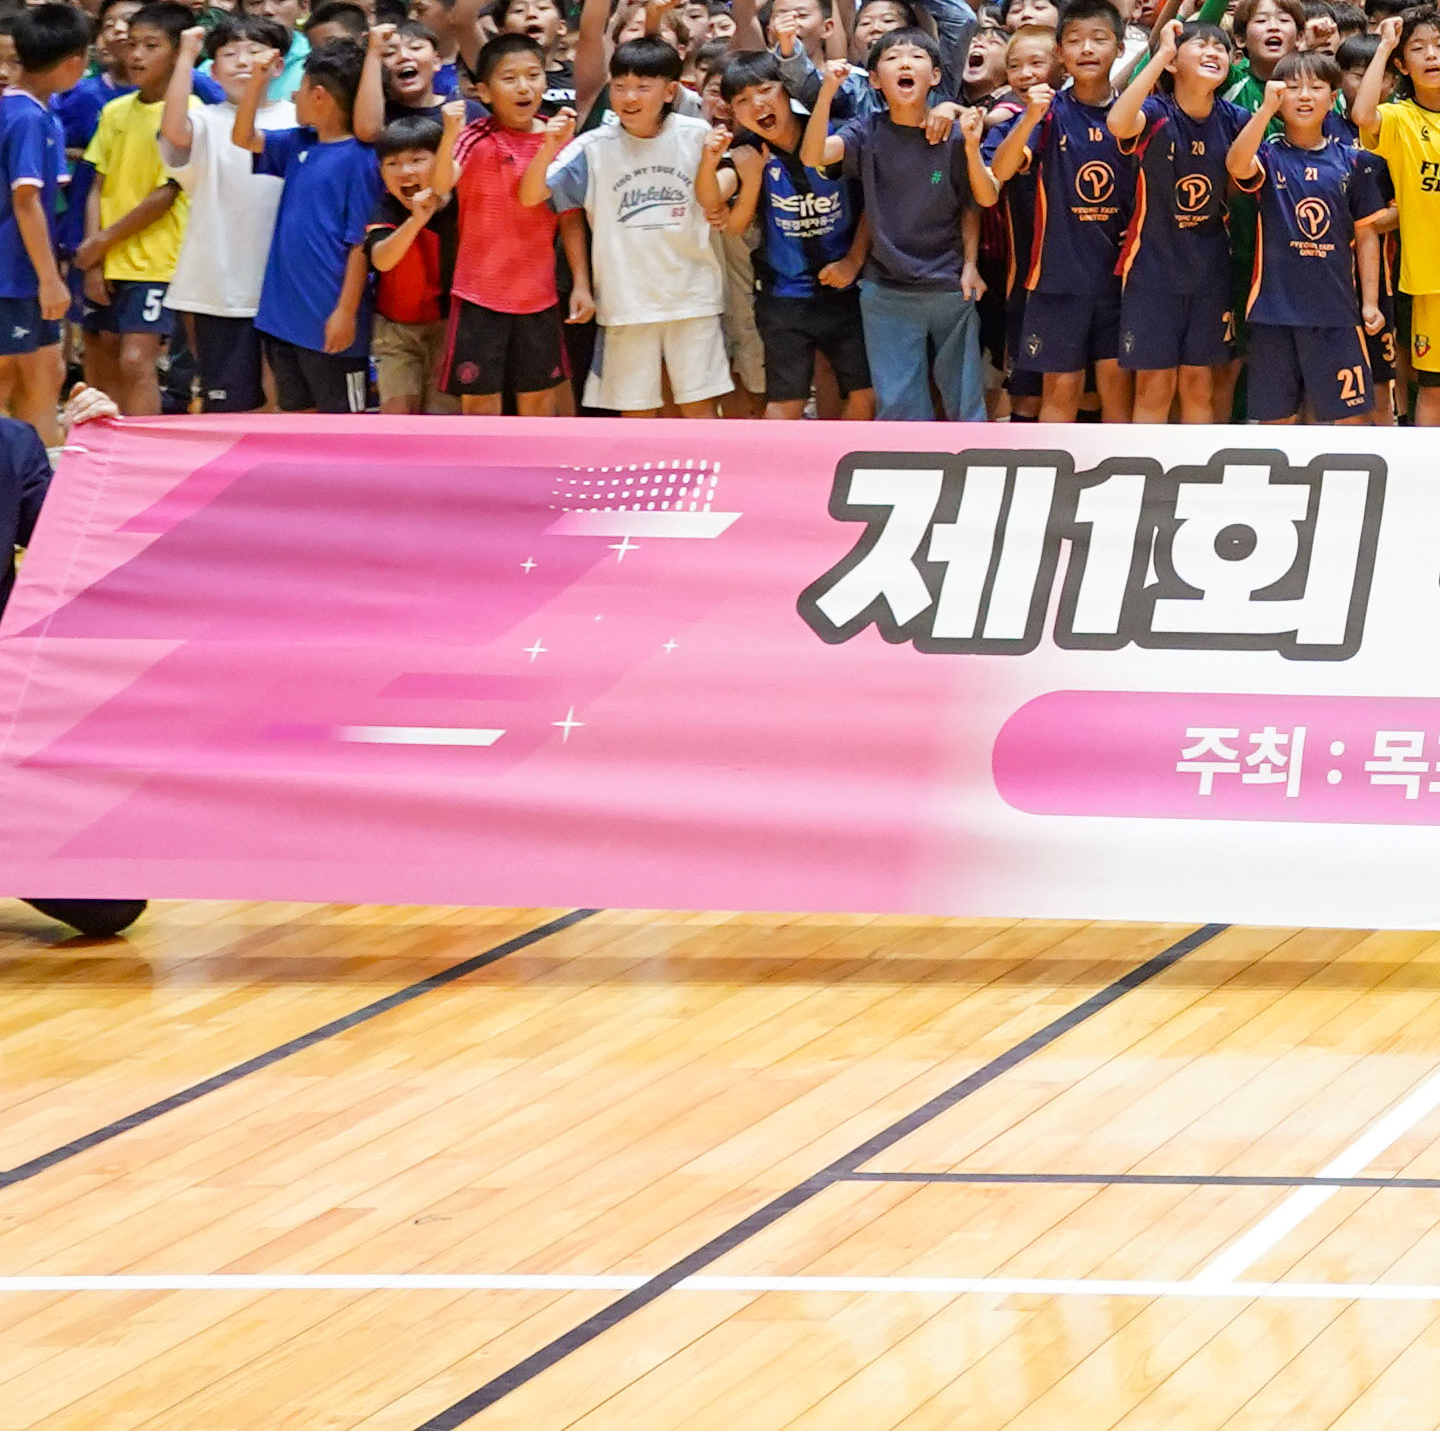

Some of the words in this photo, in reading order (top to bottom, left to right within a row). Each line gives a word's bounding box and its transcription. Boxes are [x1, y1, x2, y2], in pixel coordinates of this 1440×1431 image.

[1336, 365, 1366, 401] 21
[797, 448, 1388, 661] 제1회
[1175, 725, 1307, 798] 주최
